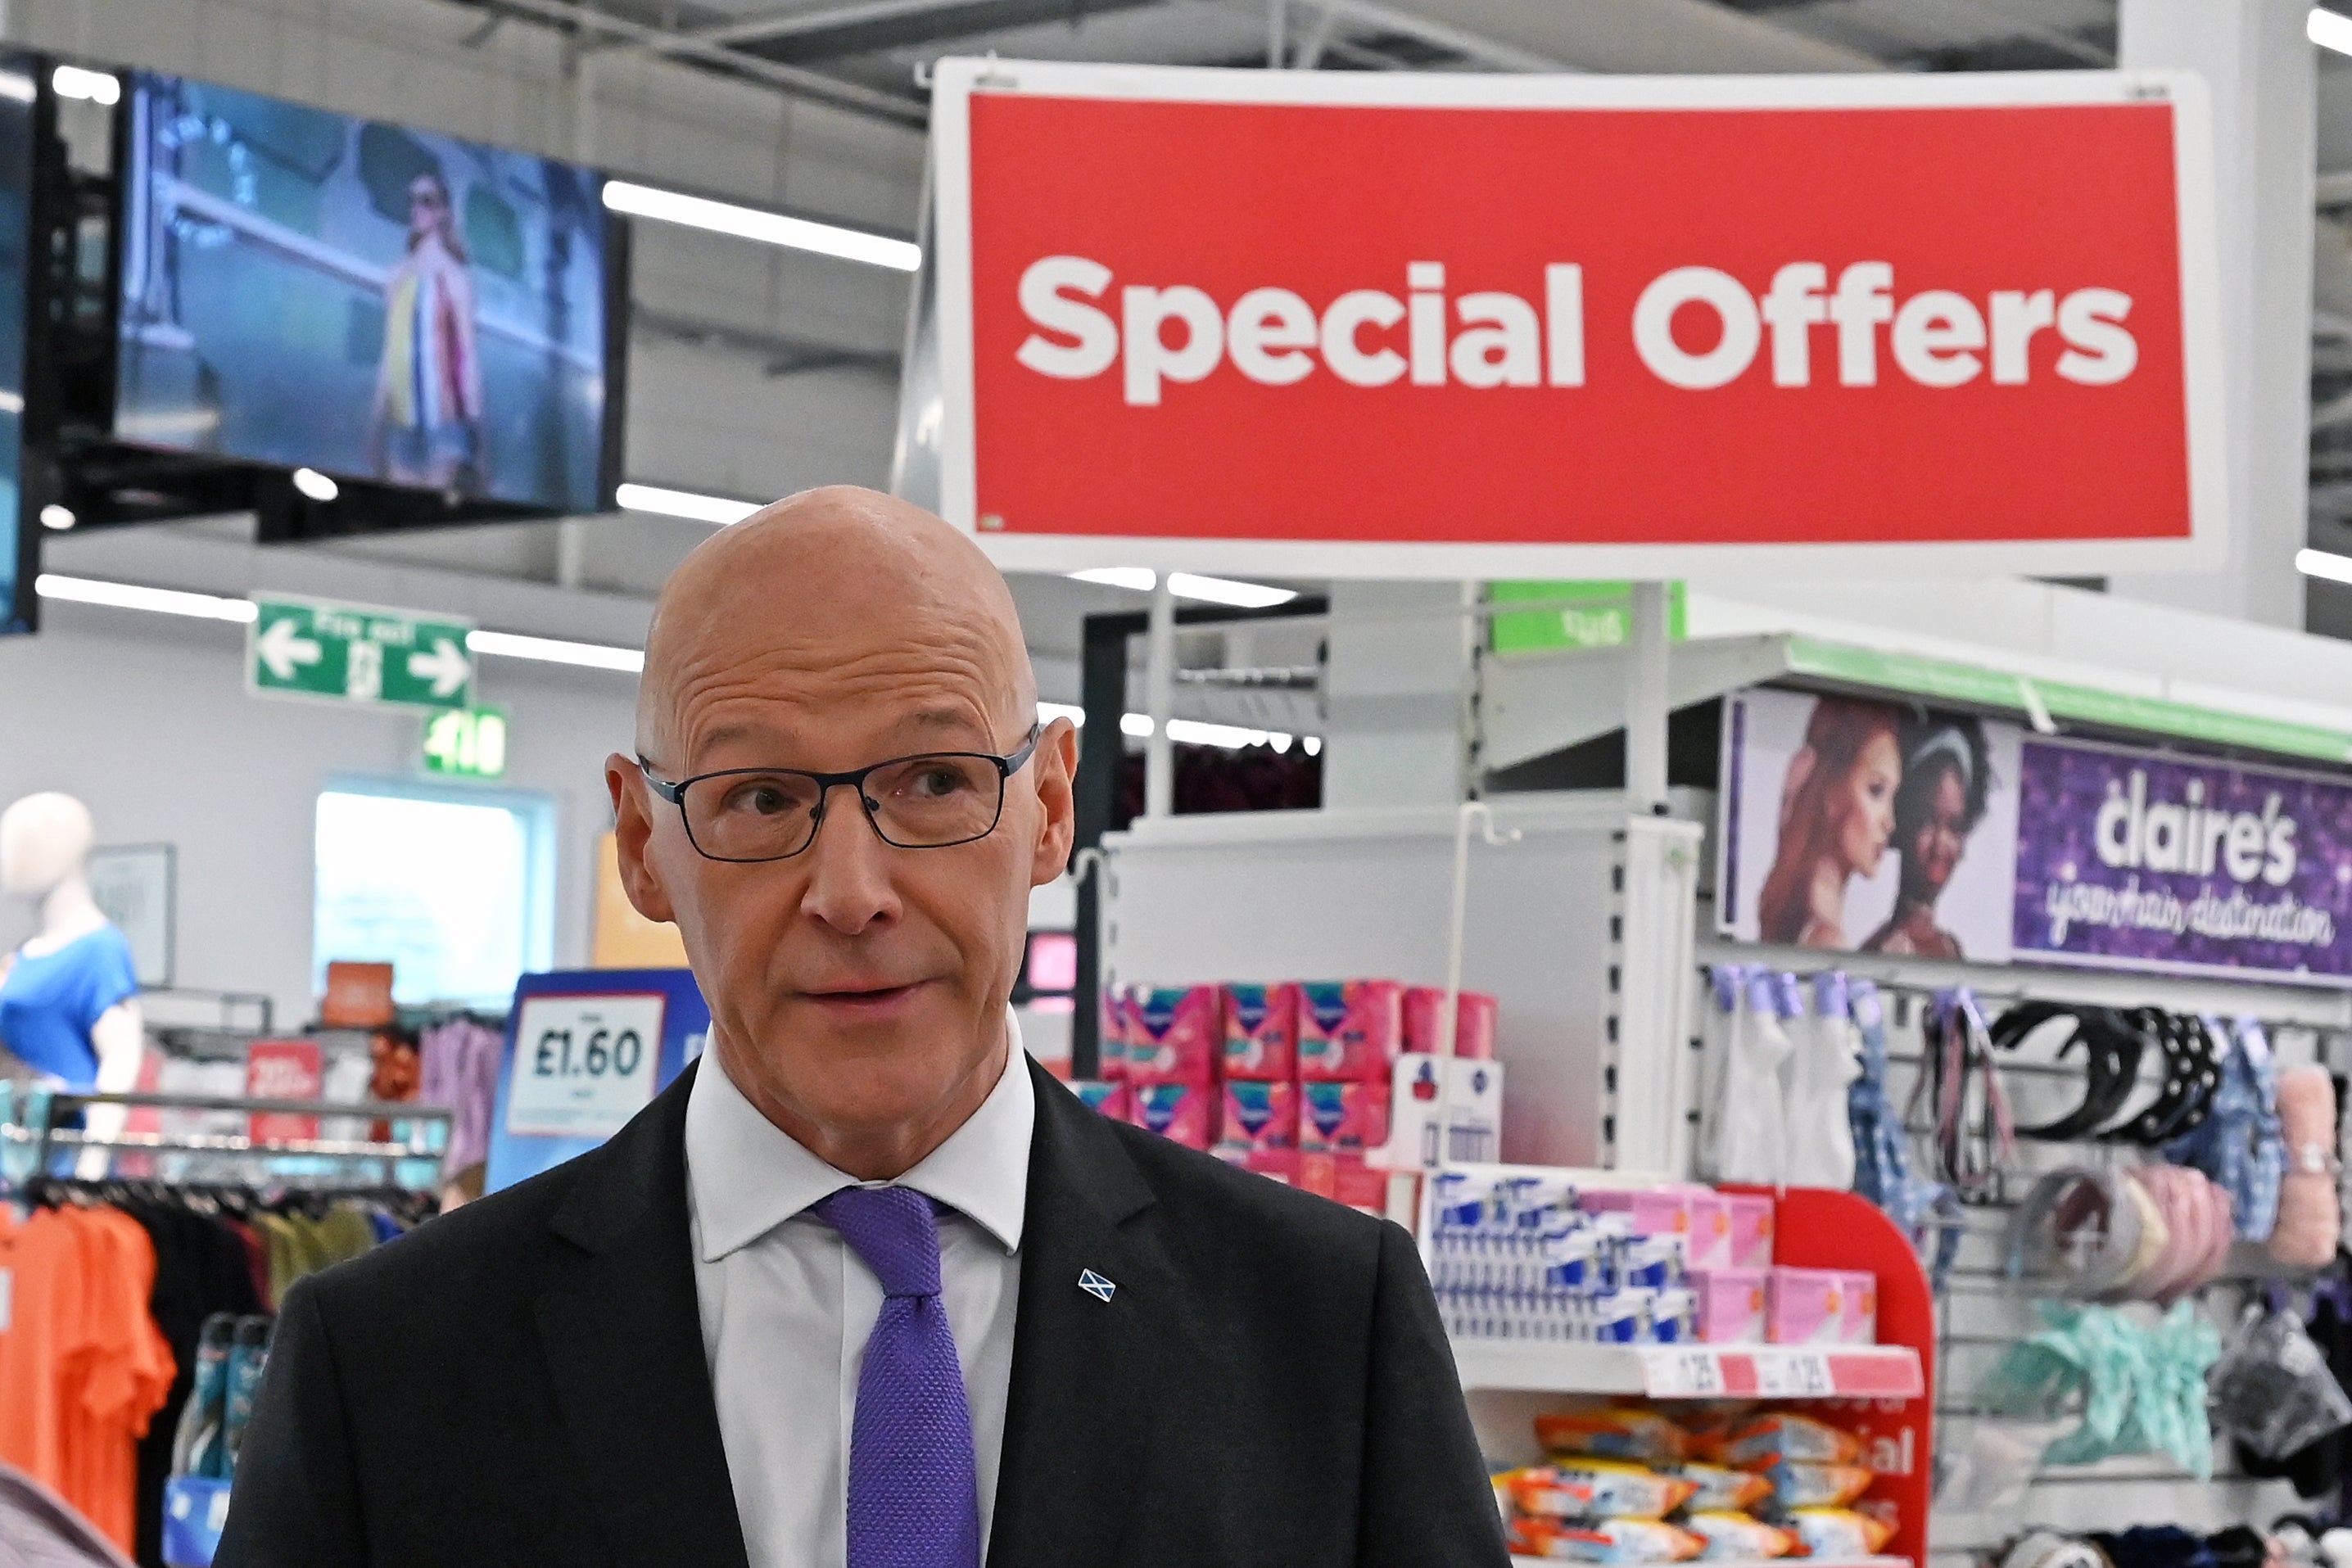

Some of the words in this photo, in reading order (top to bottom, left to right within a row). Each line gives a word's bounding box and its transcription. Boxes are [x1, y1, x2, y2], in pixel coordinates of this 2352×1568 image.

[1017, 255, 1584, 405] Special
[1632, 262, 2138, 388] Offers
[2096, 769, 2298, 887] claire's
[535, 1028, 642, 1077] £1.60
